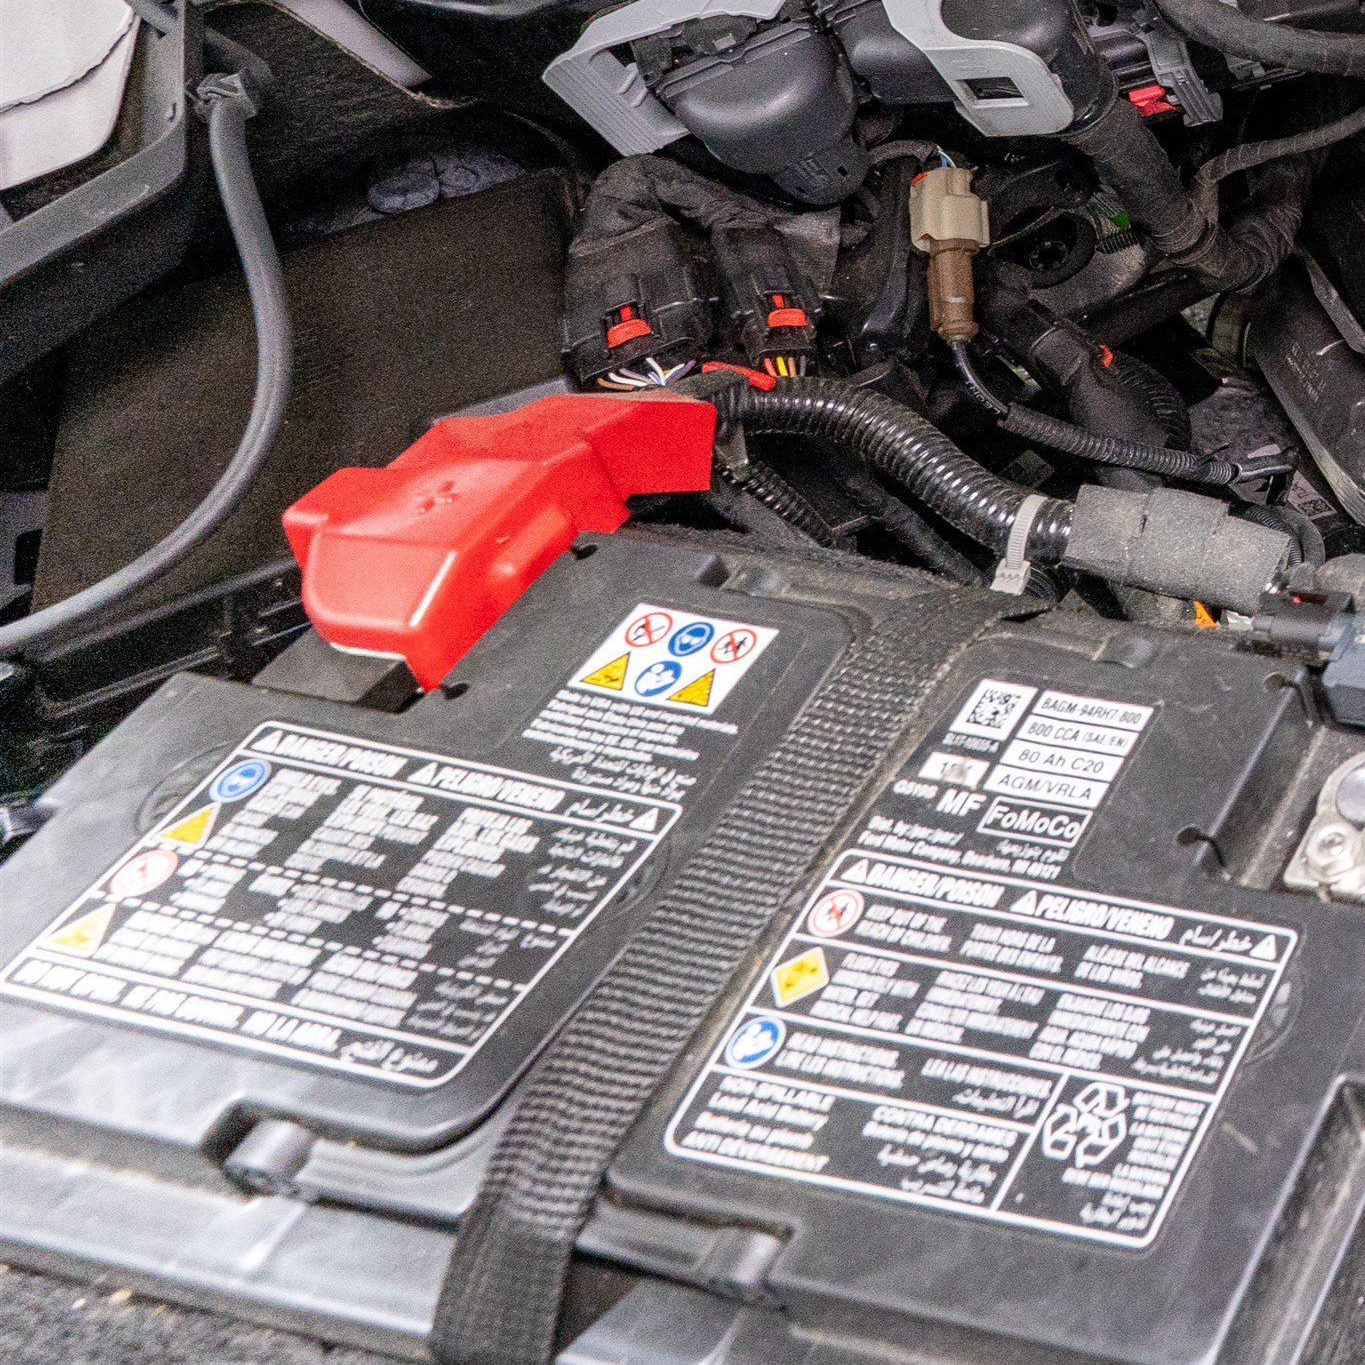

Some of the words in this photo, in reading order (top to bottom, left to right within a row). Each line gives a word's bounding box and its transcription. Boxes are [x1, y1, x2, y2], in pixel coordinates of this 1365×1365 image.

[1027, 723, 1054, 739] 800
[1053, 726, 1080, 742] CCA
[271, 733, 410, 777] DANGER/POISON
[1018, 749, 1040, 763] 80
[1043, 752, 1068, 768] Ah
[1070, 756, 1105, 774] C20
[426, 766, 568, 811] PELIGRO/VENENO
[935, 787, 986, 817] MF
[997, 773, 1093, 801] AGM/VRLA
[986, 804, 1081, 841] FoMoCo
[862, 862, 1006, 908] DANGER/POISON
[1031, 893, 1176, 940] PELIGRO/VENENO
